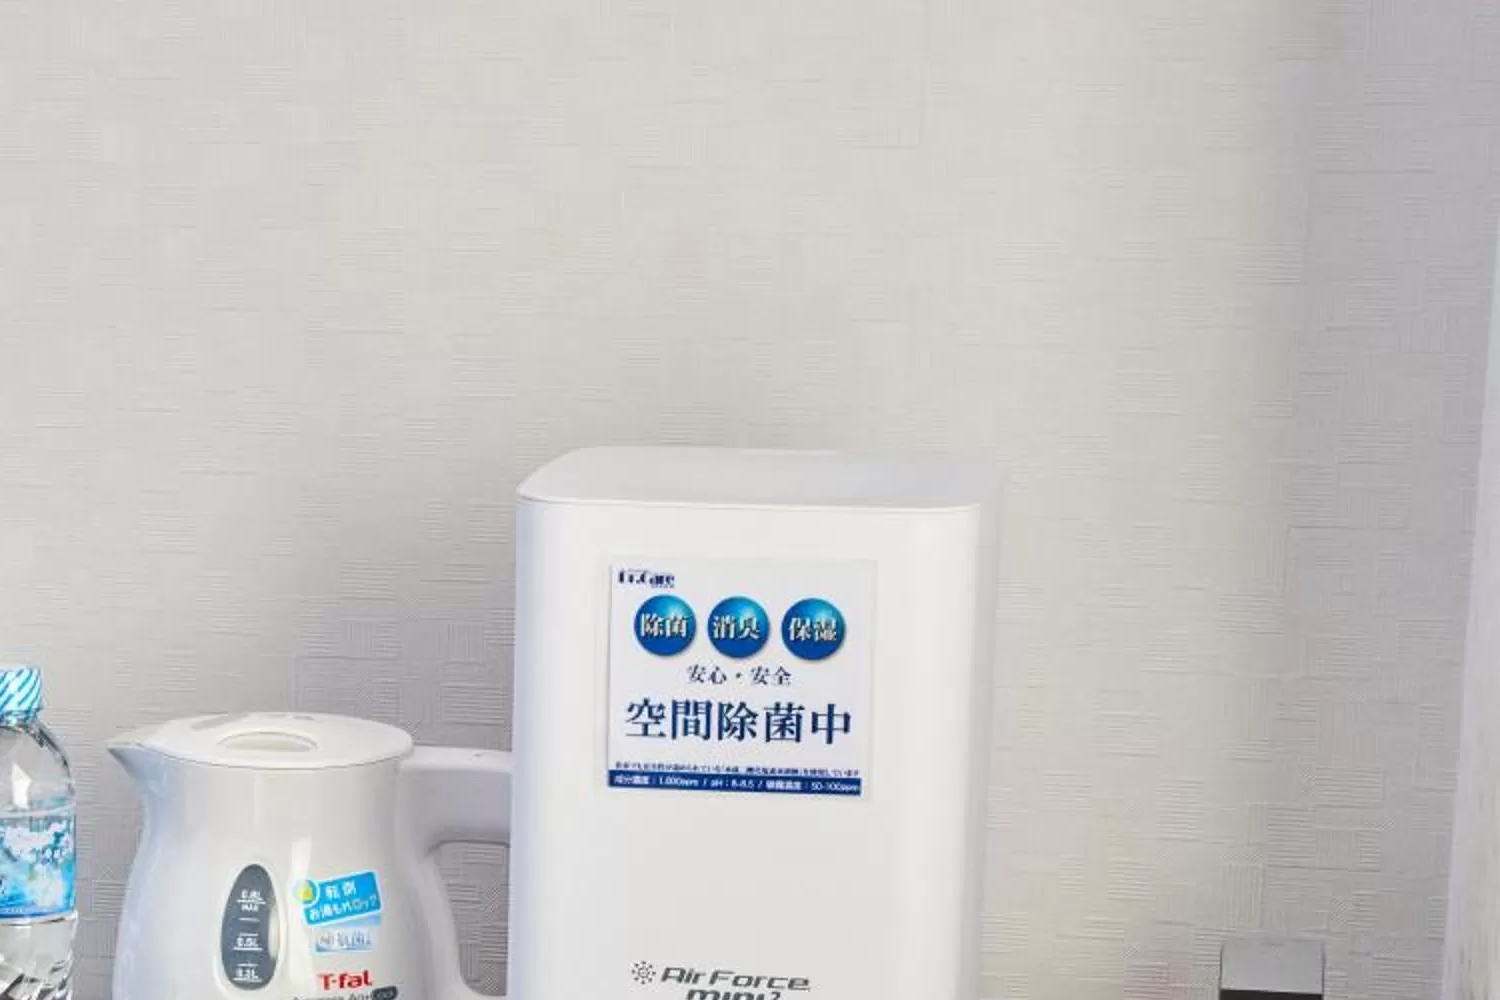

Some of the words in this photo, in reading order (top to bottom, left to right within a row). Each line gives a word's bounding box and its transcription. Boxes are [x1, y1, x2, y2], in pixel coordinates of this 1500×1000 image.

[641, 614, 688, 638] 除菌
[712, 615, 761, 640] 消臭
[788, 617, 838, 642] 保湿
[687, 664, 792, 686] 安心・安全
[625, 698, 851, 745] 空間除菌中
[316, 968, 373, 991] T-fal
